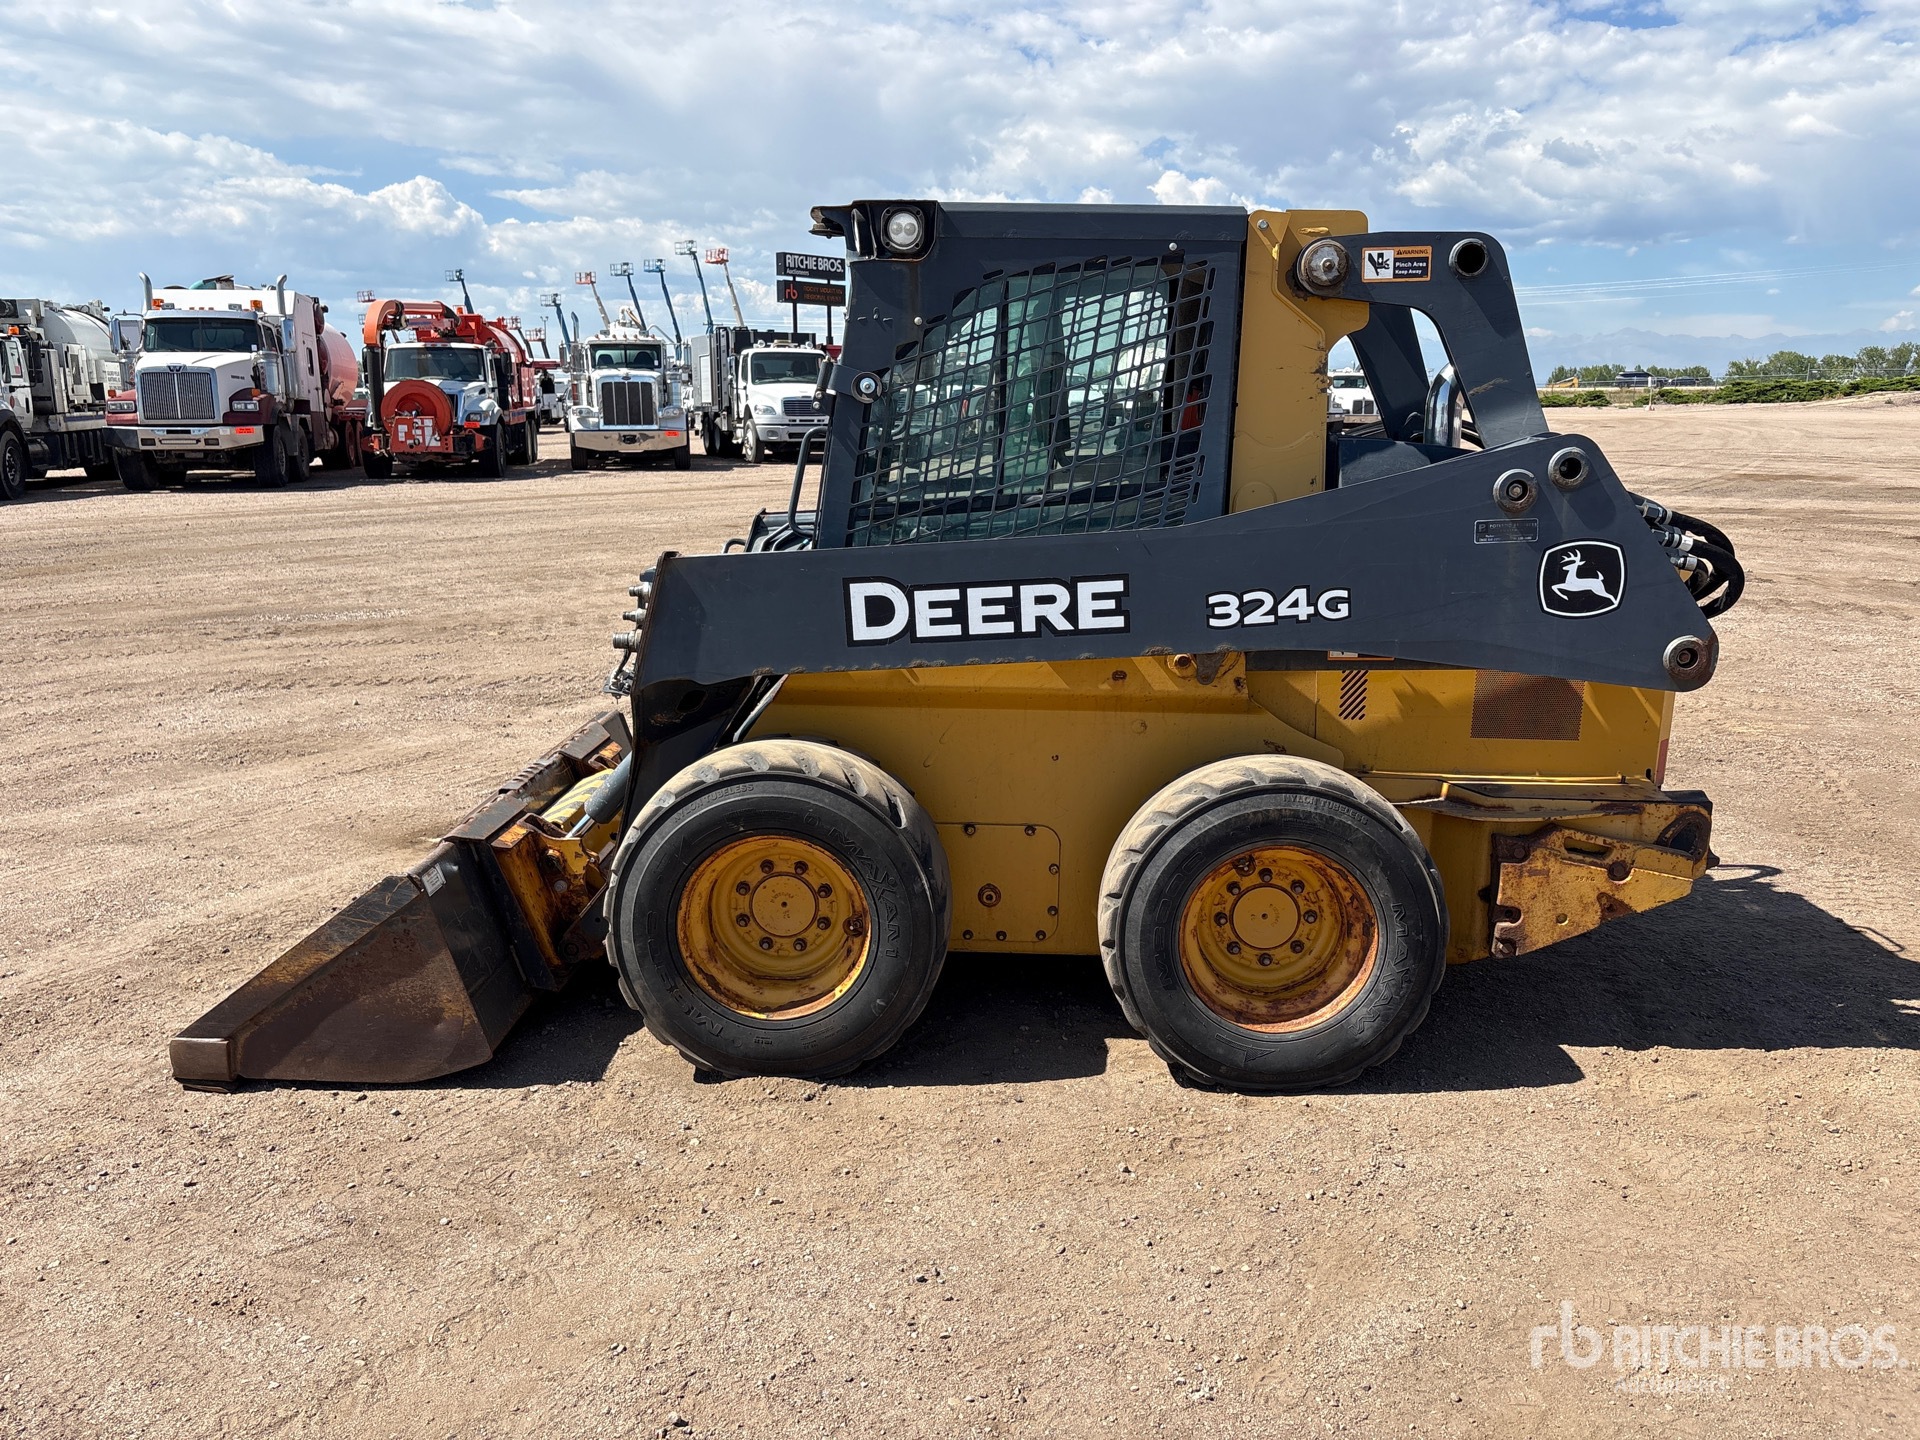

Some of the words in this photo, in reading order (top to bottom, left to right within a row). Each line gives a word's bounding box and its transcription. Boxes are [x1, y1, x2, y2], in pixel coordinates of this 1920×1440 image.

[787, 254, 817, 269] RITCHIE
[818, 258, 843, 272] BROS.
[849, 578, 1125, 642] DEERE
[1207, 587, 1350, 629] 324G
[703, 784, 754, 803] TUBELESS
[828, 827, 900, 958] MAXAM
[1347, 902, 1410, 1036] MAXAM
